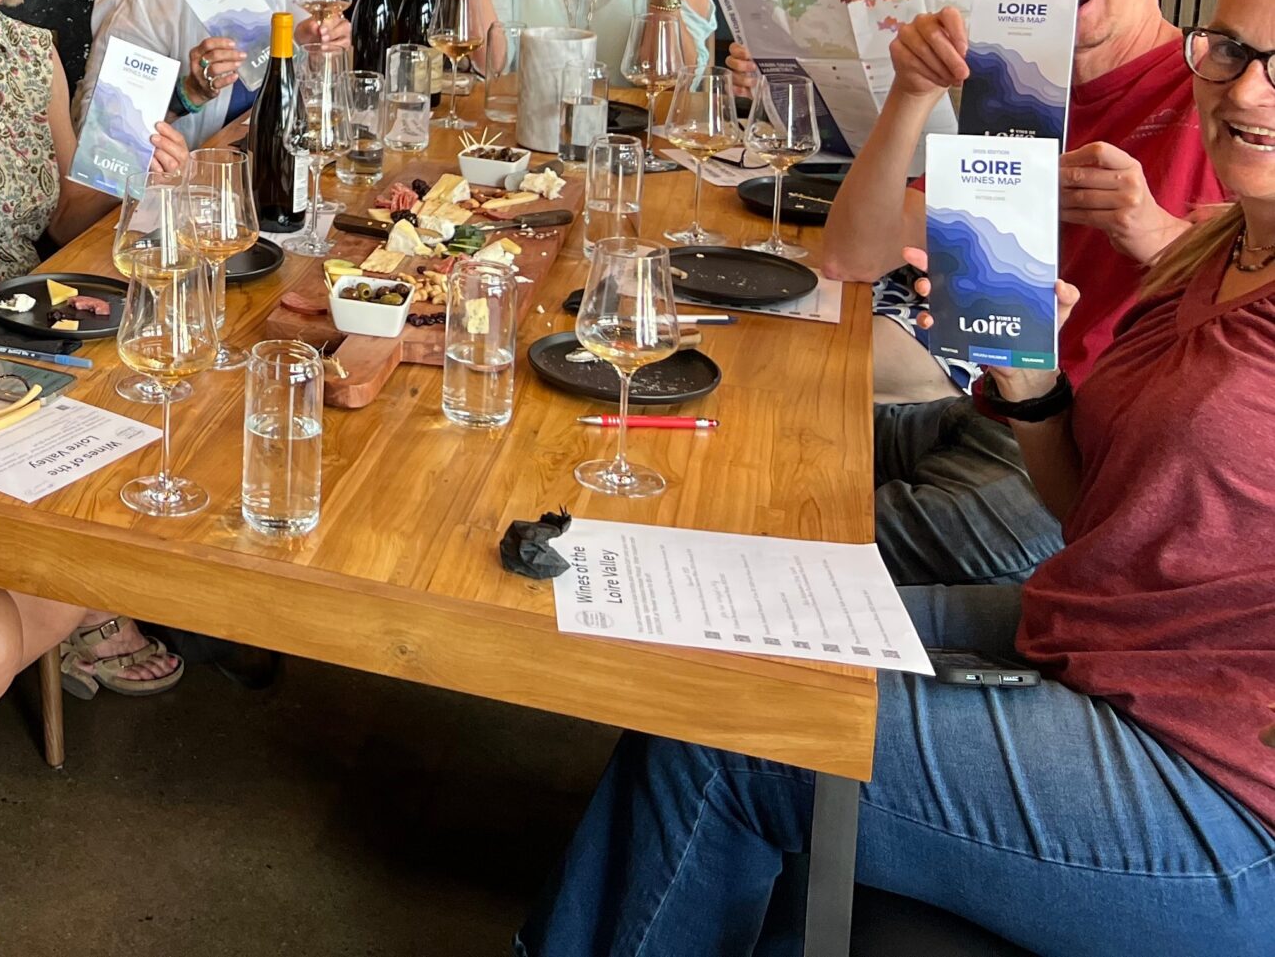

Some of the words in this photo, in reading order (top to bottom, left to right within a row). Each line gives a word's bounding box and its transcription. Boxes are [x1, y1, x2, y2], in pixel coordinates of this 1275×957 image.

[998, 3, 1047, 16] LOIRE
[998, 16, 1025, 24] WINES
[124, 56, 159, 76] LOIRE
[93, 154, 130, 176] Loire
[961, 159, 1022, 175] LOIRE
[961, 176, 995, 184] WINES
[997, 177, 1022, 186] MAP
[959, 314, 1022, 337] Loire
[65, 435, 100, 452] Loire
[83, 440, 123, 459] Wines
[28, 449, 70, 468] Valley
[69, 457, 84, 468] of
[47, 464, 72, 477] the
[573, 545, 586, 562] the
[571, 561, 589, 575] of
[599, 548, 620, 577] Valley
[575, 575, 593, 604] Wines
[604, 578, 623, 604] Loire
